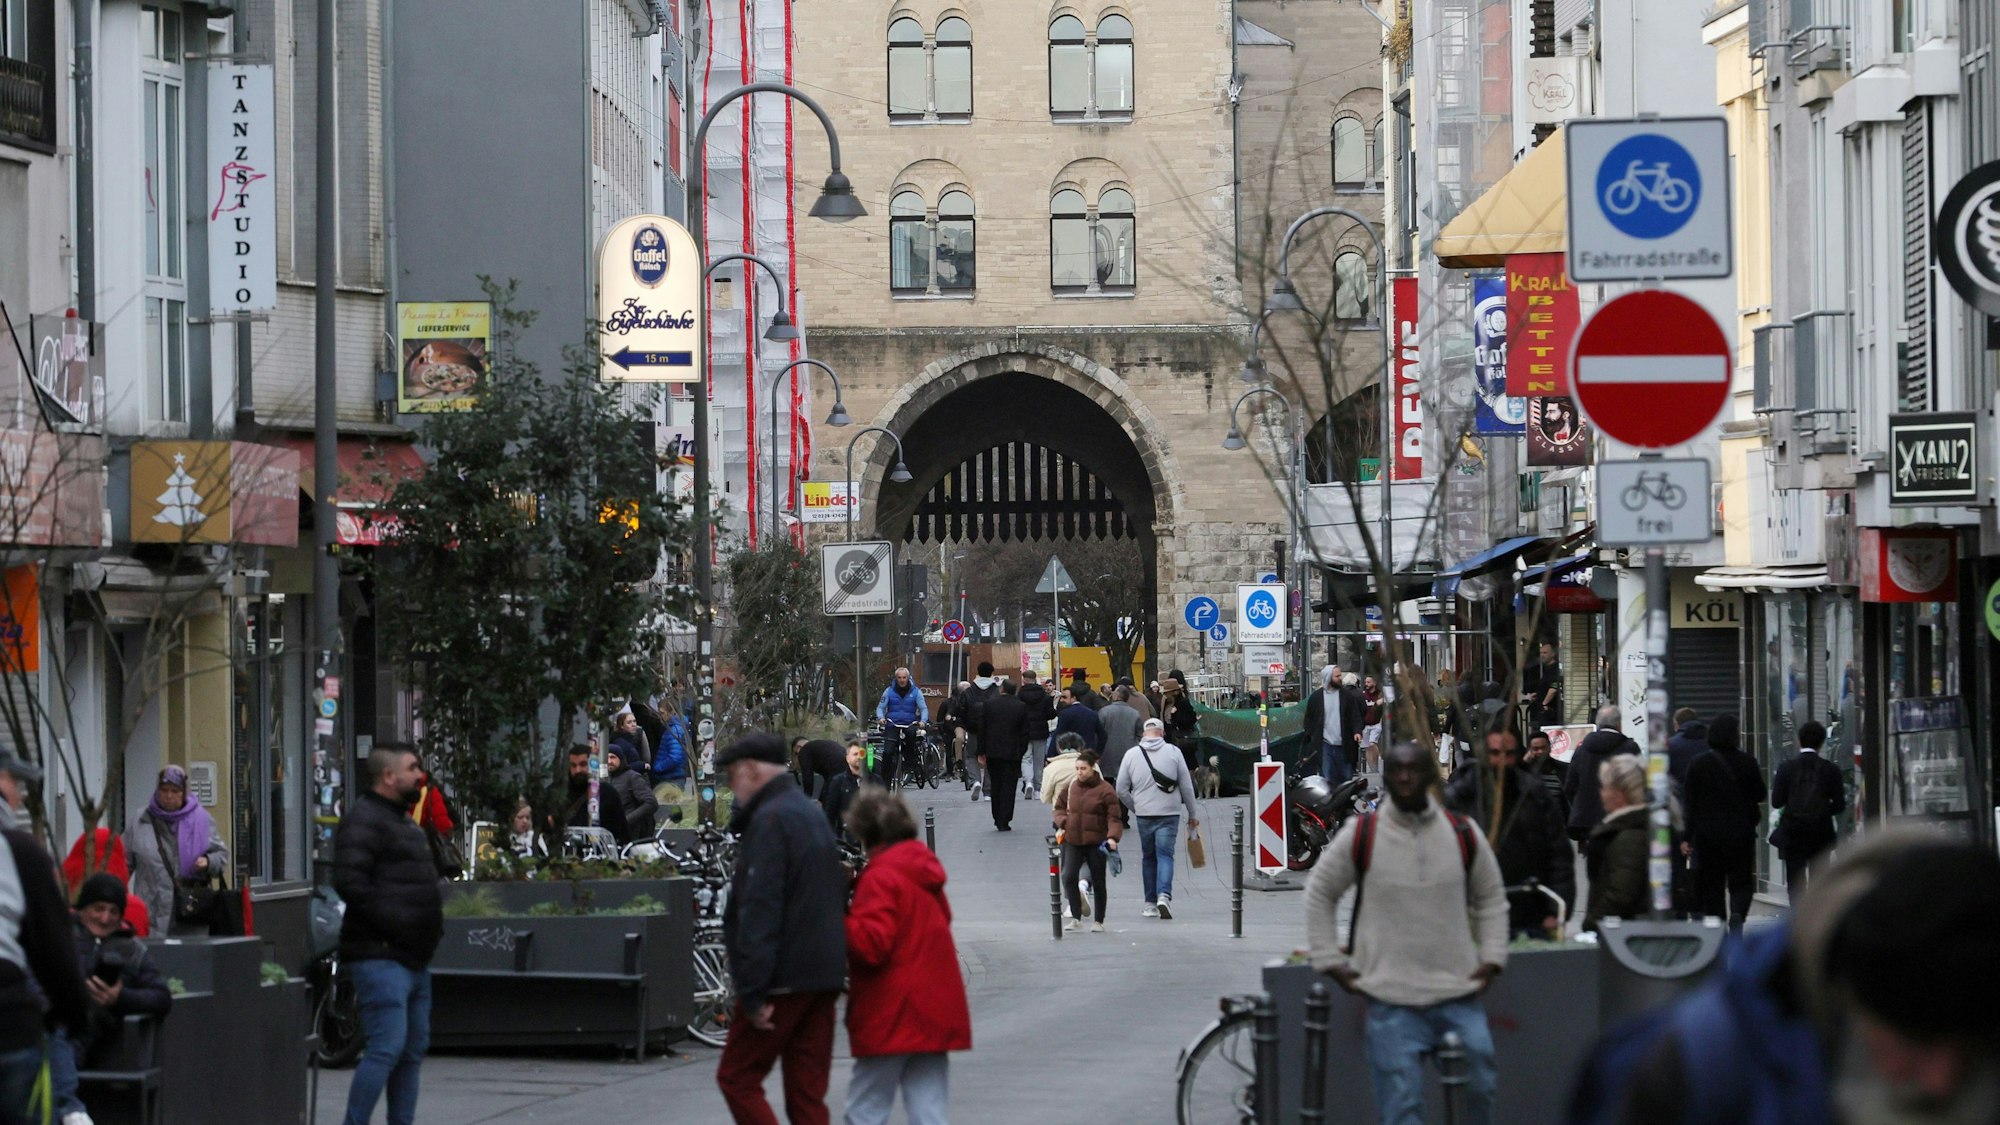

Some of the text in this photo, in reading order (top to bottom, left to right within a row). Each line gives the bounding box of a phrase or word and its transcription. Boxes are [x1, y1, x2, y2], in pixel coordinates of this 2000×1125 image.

[1543, 88, 1567, 99] KRALL
[232, 75, 251, 304] TANZSTUDIO
[633, 248, 667, 262] Gaffel
[1579, 248, 1722, 270] Fahrradstraße
[1510, 271, 1569, 292] KRALL
[417, 324, 471, 332] LIEFERSERVICE
[606, 309, 695, 336] Eigelschänke
[1527, 295, 1555, 392] BETTEN
[644, 354, 657, 363] 15
[1535, 434, 1586, 453] CLASSIC
[1915, 467, 1958, 480] FRISEUR
[804, 494, 857, 507] Linden
[1637, 515, 1673, 534] frei
[1240, 631, 1283, 639] Fahrradstraße
